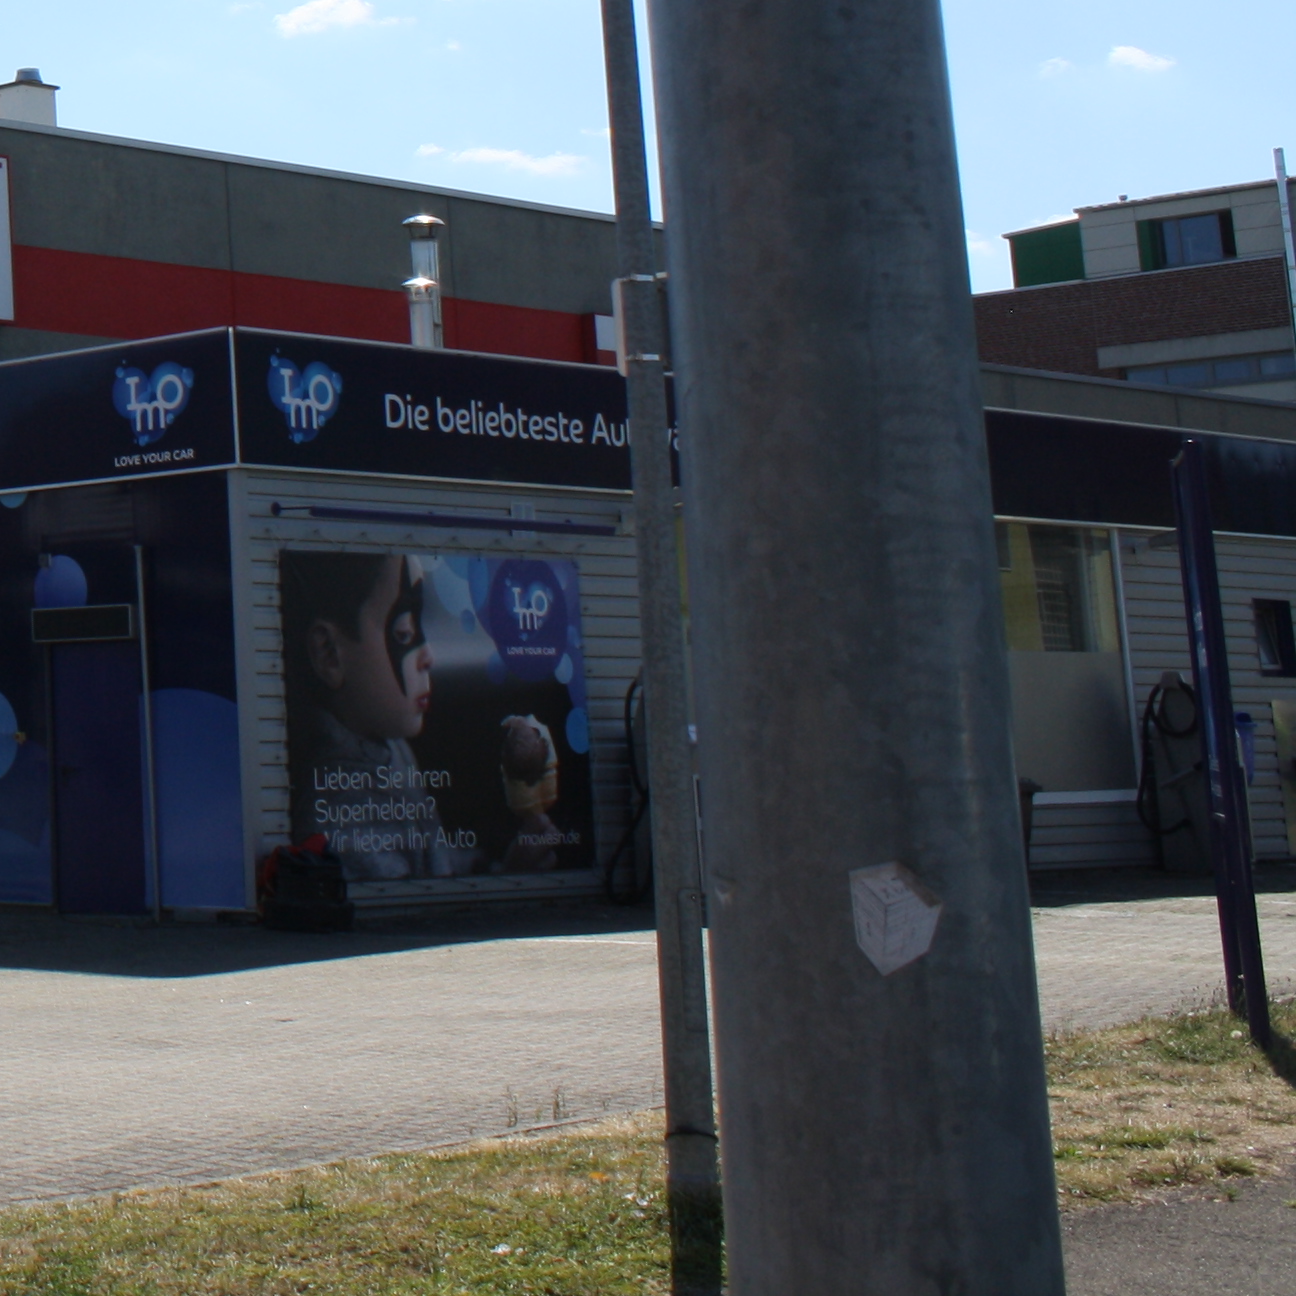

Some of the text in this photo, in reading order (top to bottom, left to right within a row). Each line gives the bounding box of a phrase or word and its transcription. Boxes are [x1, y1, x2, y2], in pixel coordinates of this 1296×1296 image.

[384, 393, 431, 431] Die
[436, 397, 584, 444] beliebteste
[114, 448, 195, 468] LOVE YOUR CAR
[313, 766, 451, 791] Lieben Sie Ihren
[314, 796, 436, 828] Superhelden?
[352, 829, 402, 852] lieben
[407, 828, 429, 850] Ihr
[434, 825, 477, 849] Auto
